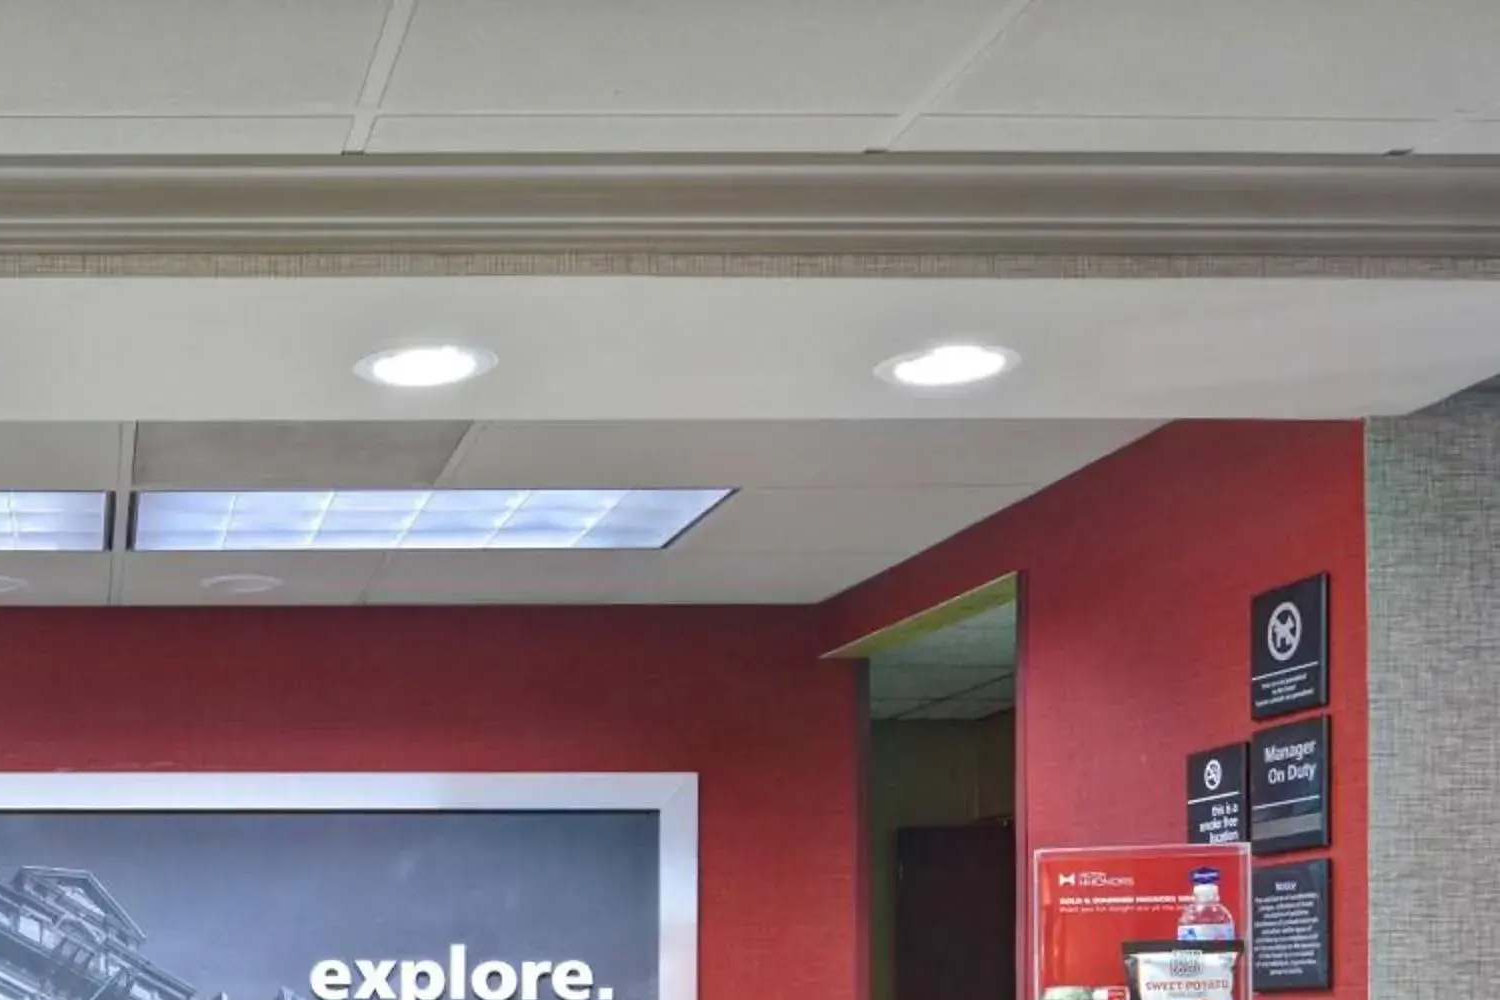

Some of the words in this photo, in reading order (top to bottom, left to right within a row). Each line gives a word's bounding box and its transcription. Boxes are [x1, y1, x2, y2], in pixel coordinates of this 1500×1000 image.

[1264, 740, 1316, 763] Manager
[1268, 768, 1285, 784] On
[1287, 763, 1317, 781] Duty
